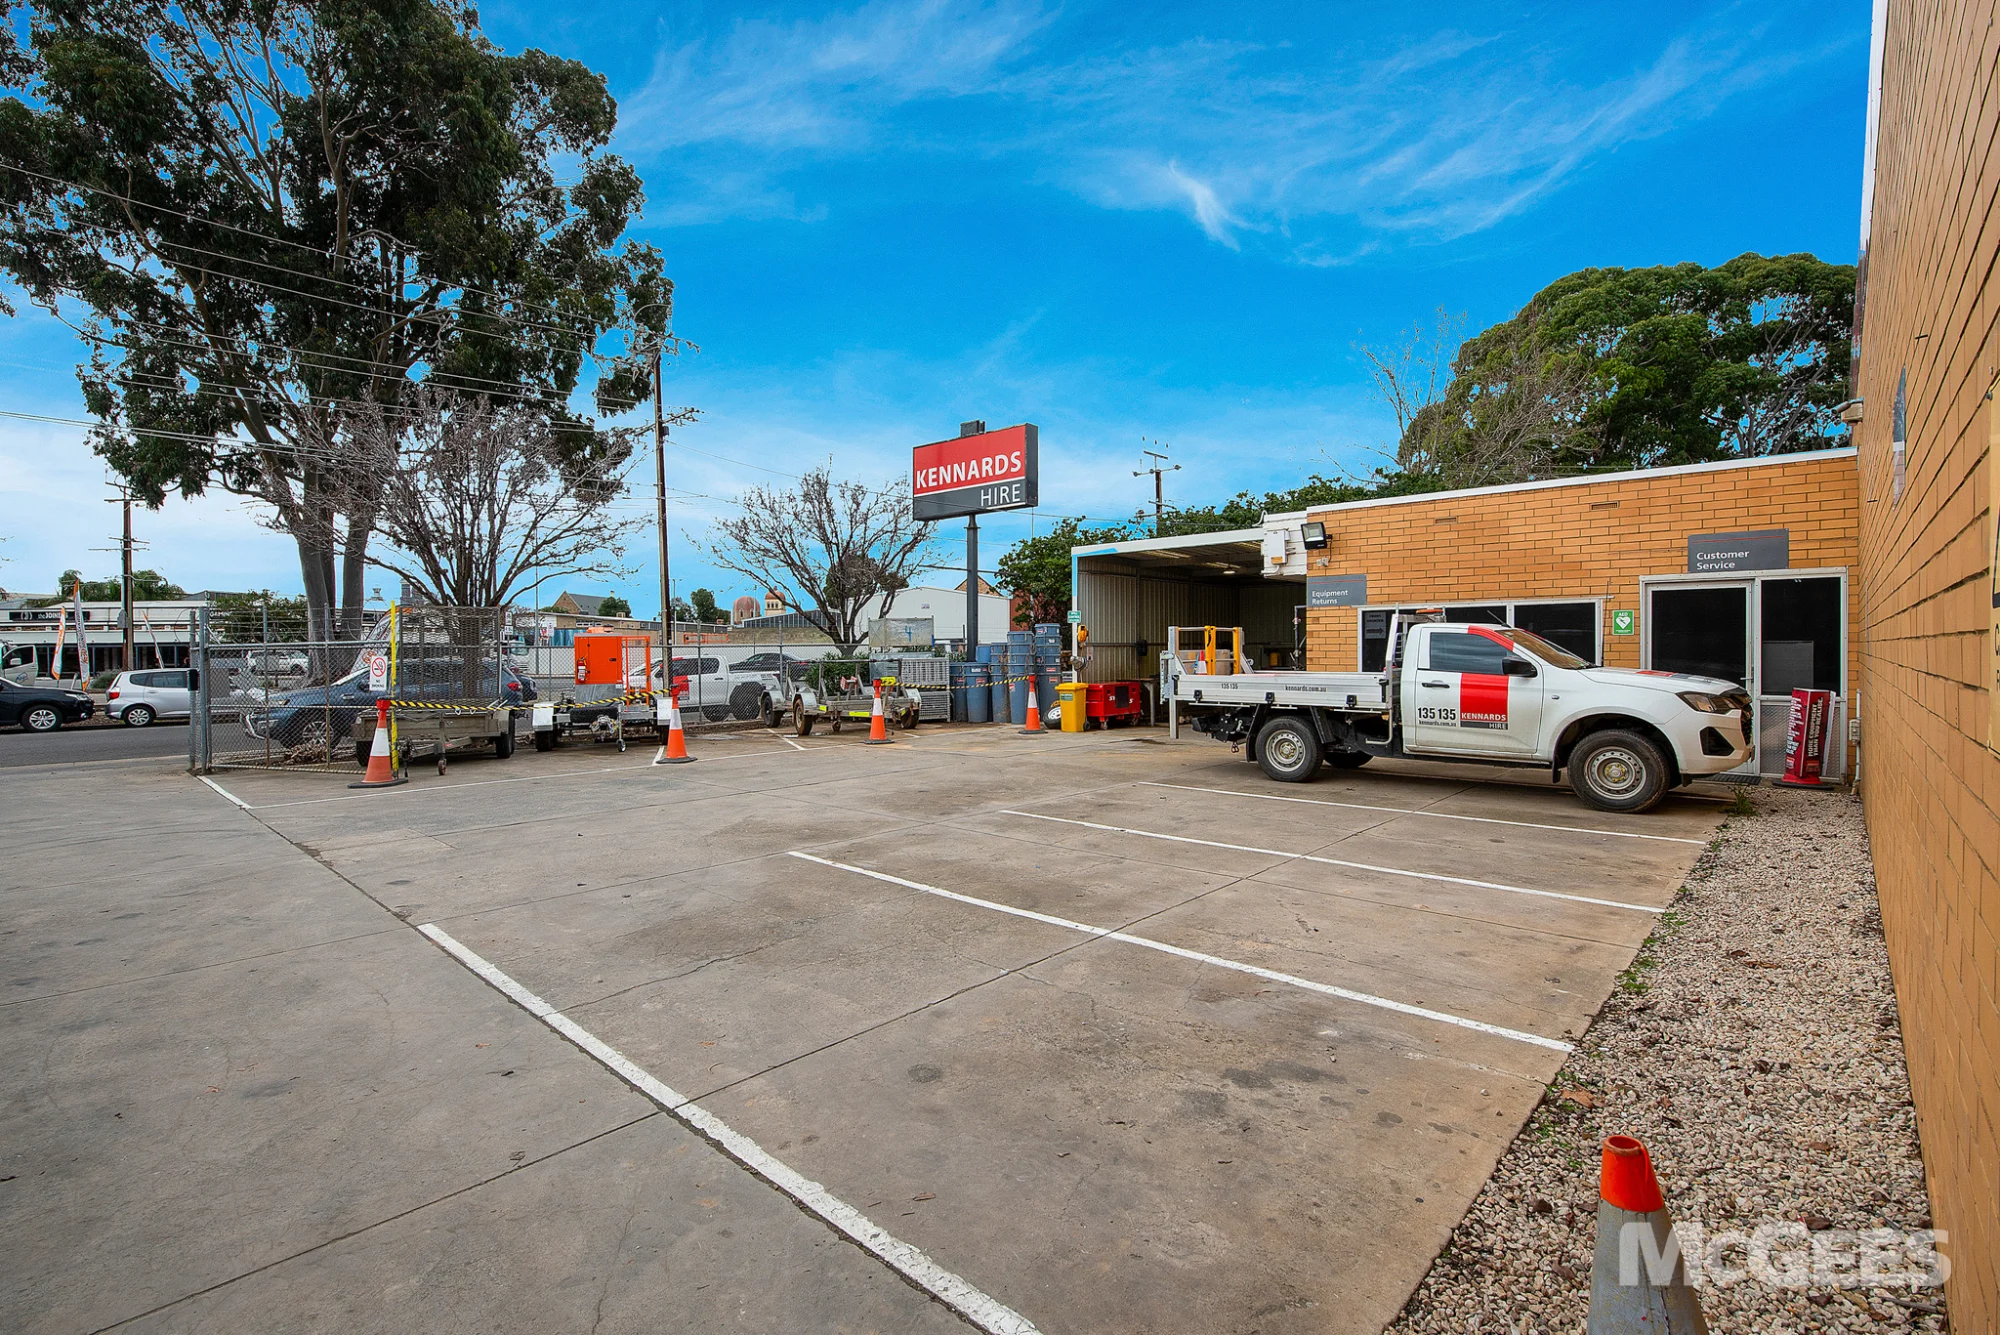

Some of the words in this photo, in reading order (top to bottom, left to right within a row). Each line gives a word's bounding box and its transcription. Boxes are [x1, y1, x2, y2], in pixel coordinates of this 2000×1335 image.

[916, 451, 1022, 489] KENNARDS
[980, 483, 1021, 507] HIRE
[1696, 551, 1750, 560] Customer
[1696, 561, 1735, 570] Service
[1311, 589, 1349, 598] Equipment
[1285, 684, 1327, 692] kennards.com.au
[1418, 707, 1435, 719] 135
[1438, 708, 1456, 721] 135
[1461, 712, 1507, 721] KENNARDS
[1489, 722, 1506, 730] HIRE
